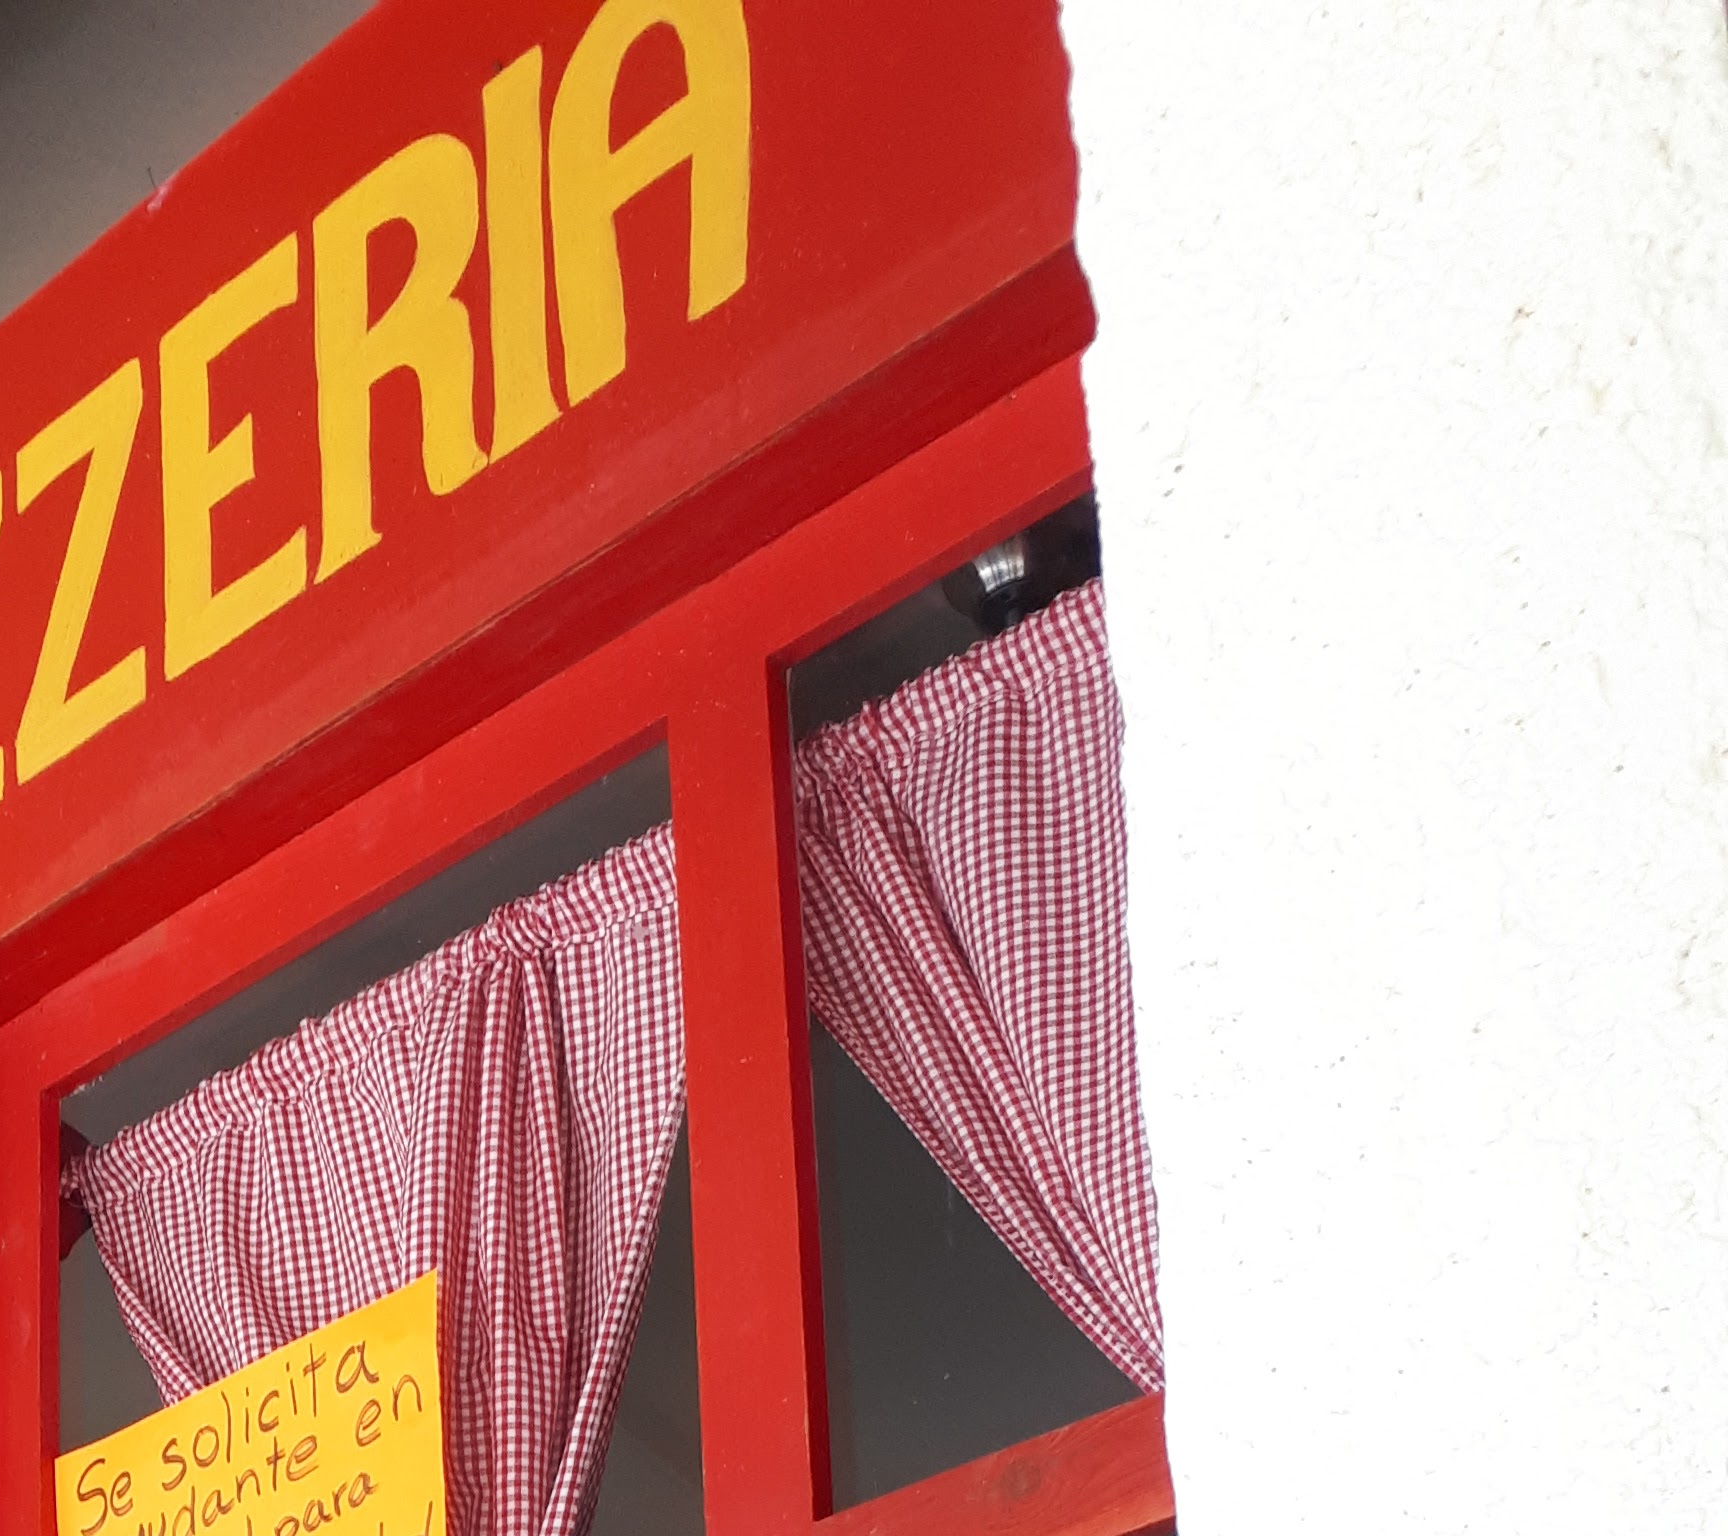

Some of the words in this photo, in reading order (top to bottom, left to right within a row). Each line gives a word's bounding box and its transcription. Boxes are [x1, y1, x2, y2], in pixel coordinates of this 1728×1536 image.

[76, 1457, 133, 1536] Se
[162, 1341, 379, 1491] solicita
[355, 1374, 422, 1447] en
